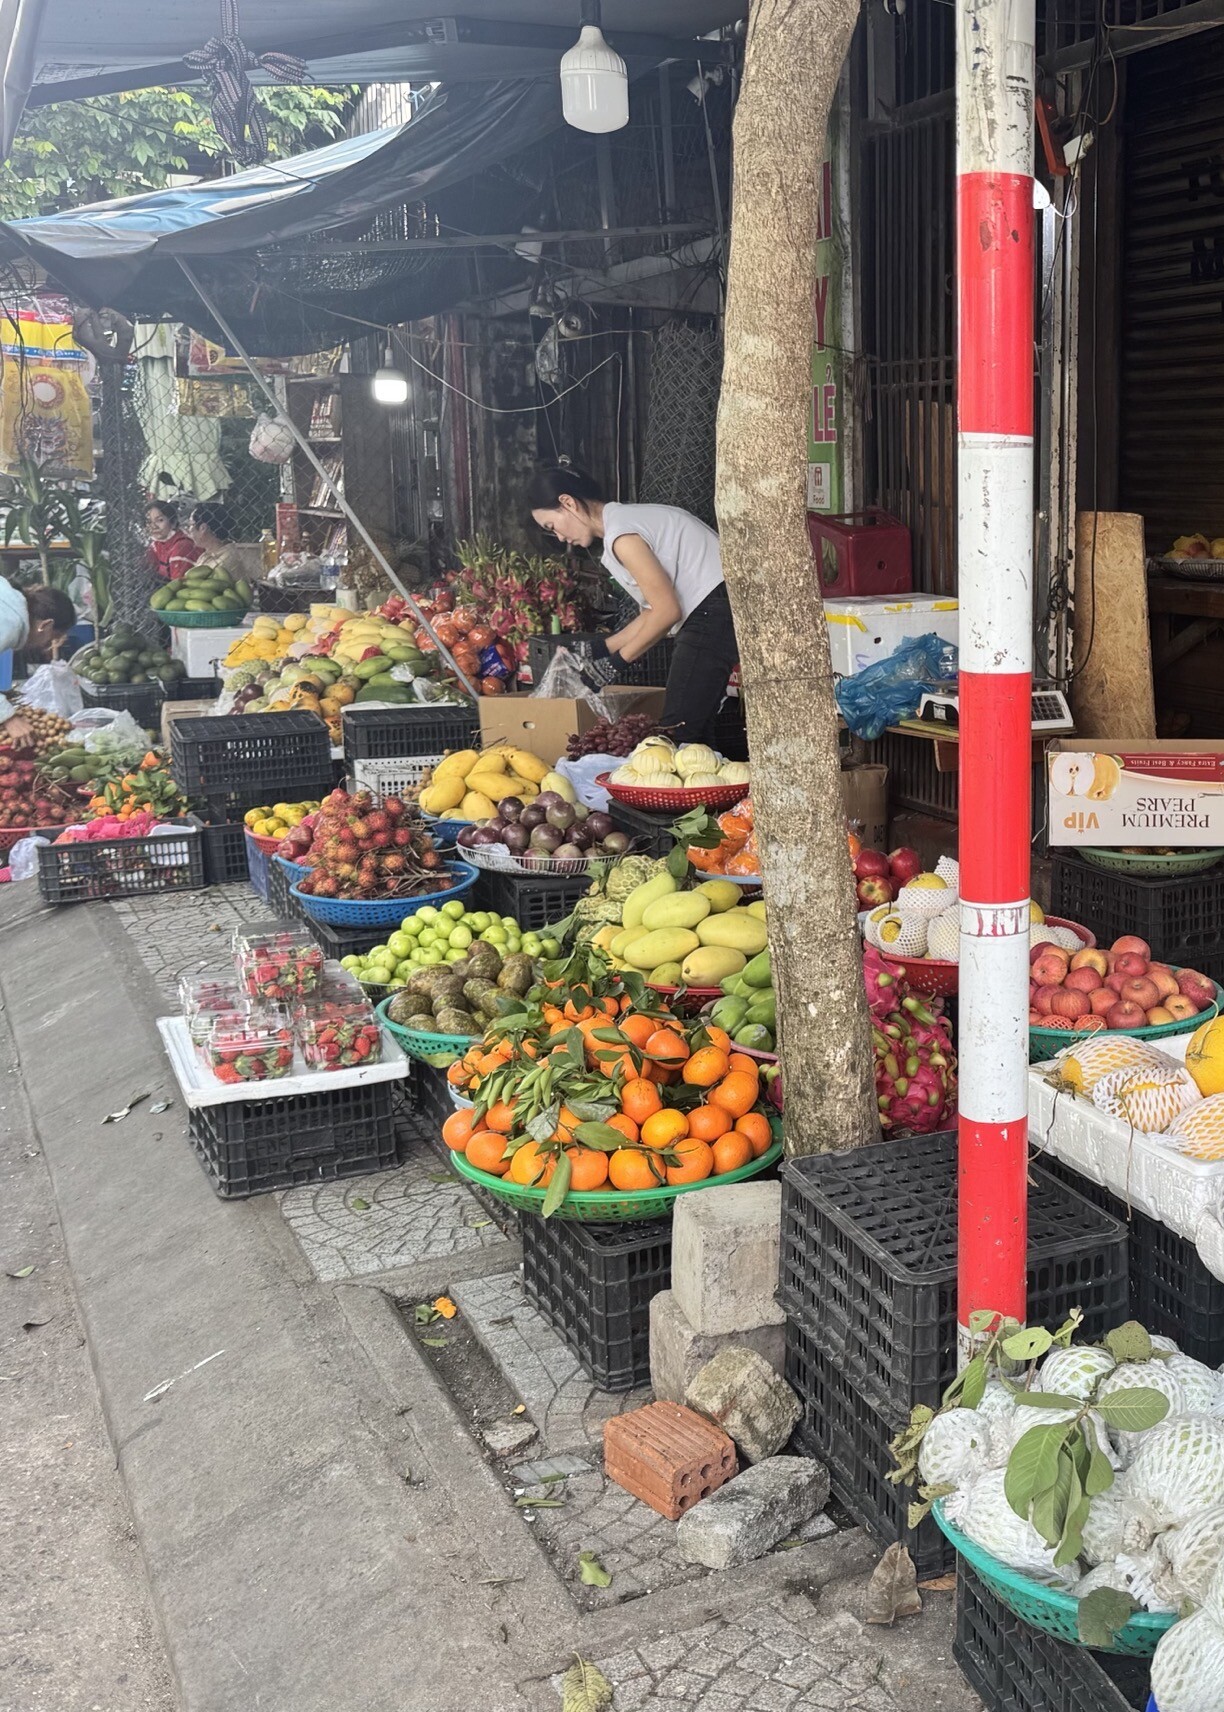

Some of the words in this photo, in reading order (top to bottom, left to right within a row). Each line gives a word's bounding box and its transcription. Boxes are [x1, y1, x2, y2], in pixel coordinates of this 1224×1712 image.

[1176, 759, 1197, 767] Fancy
[1199, 759, 1216, 767] Extra
[1136, 797, 1195, 812] PEARS
[1063, 811, 1100, 833] VIP
[1122, 814, 1210, 828] PREMIUM
